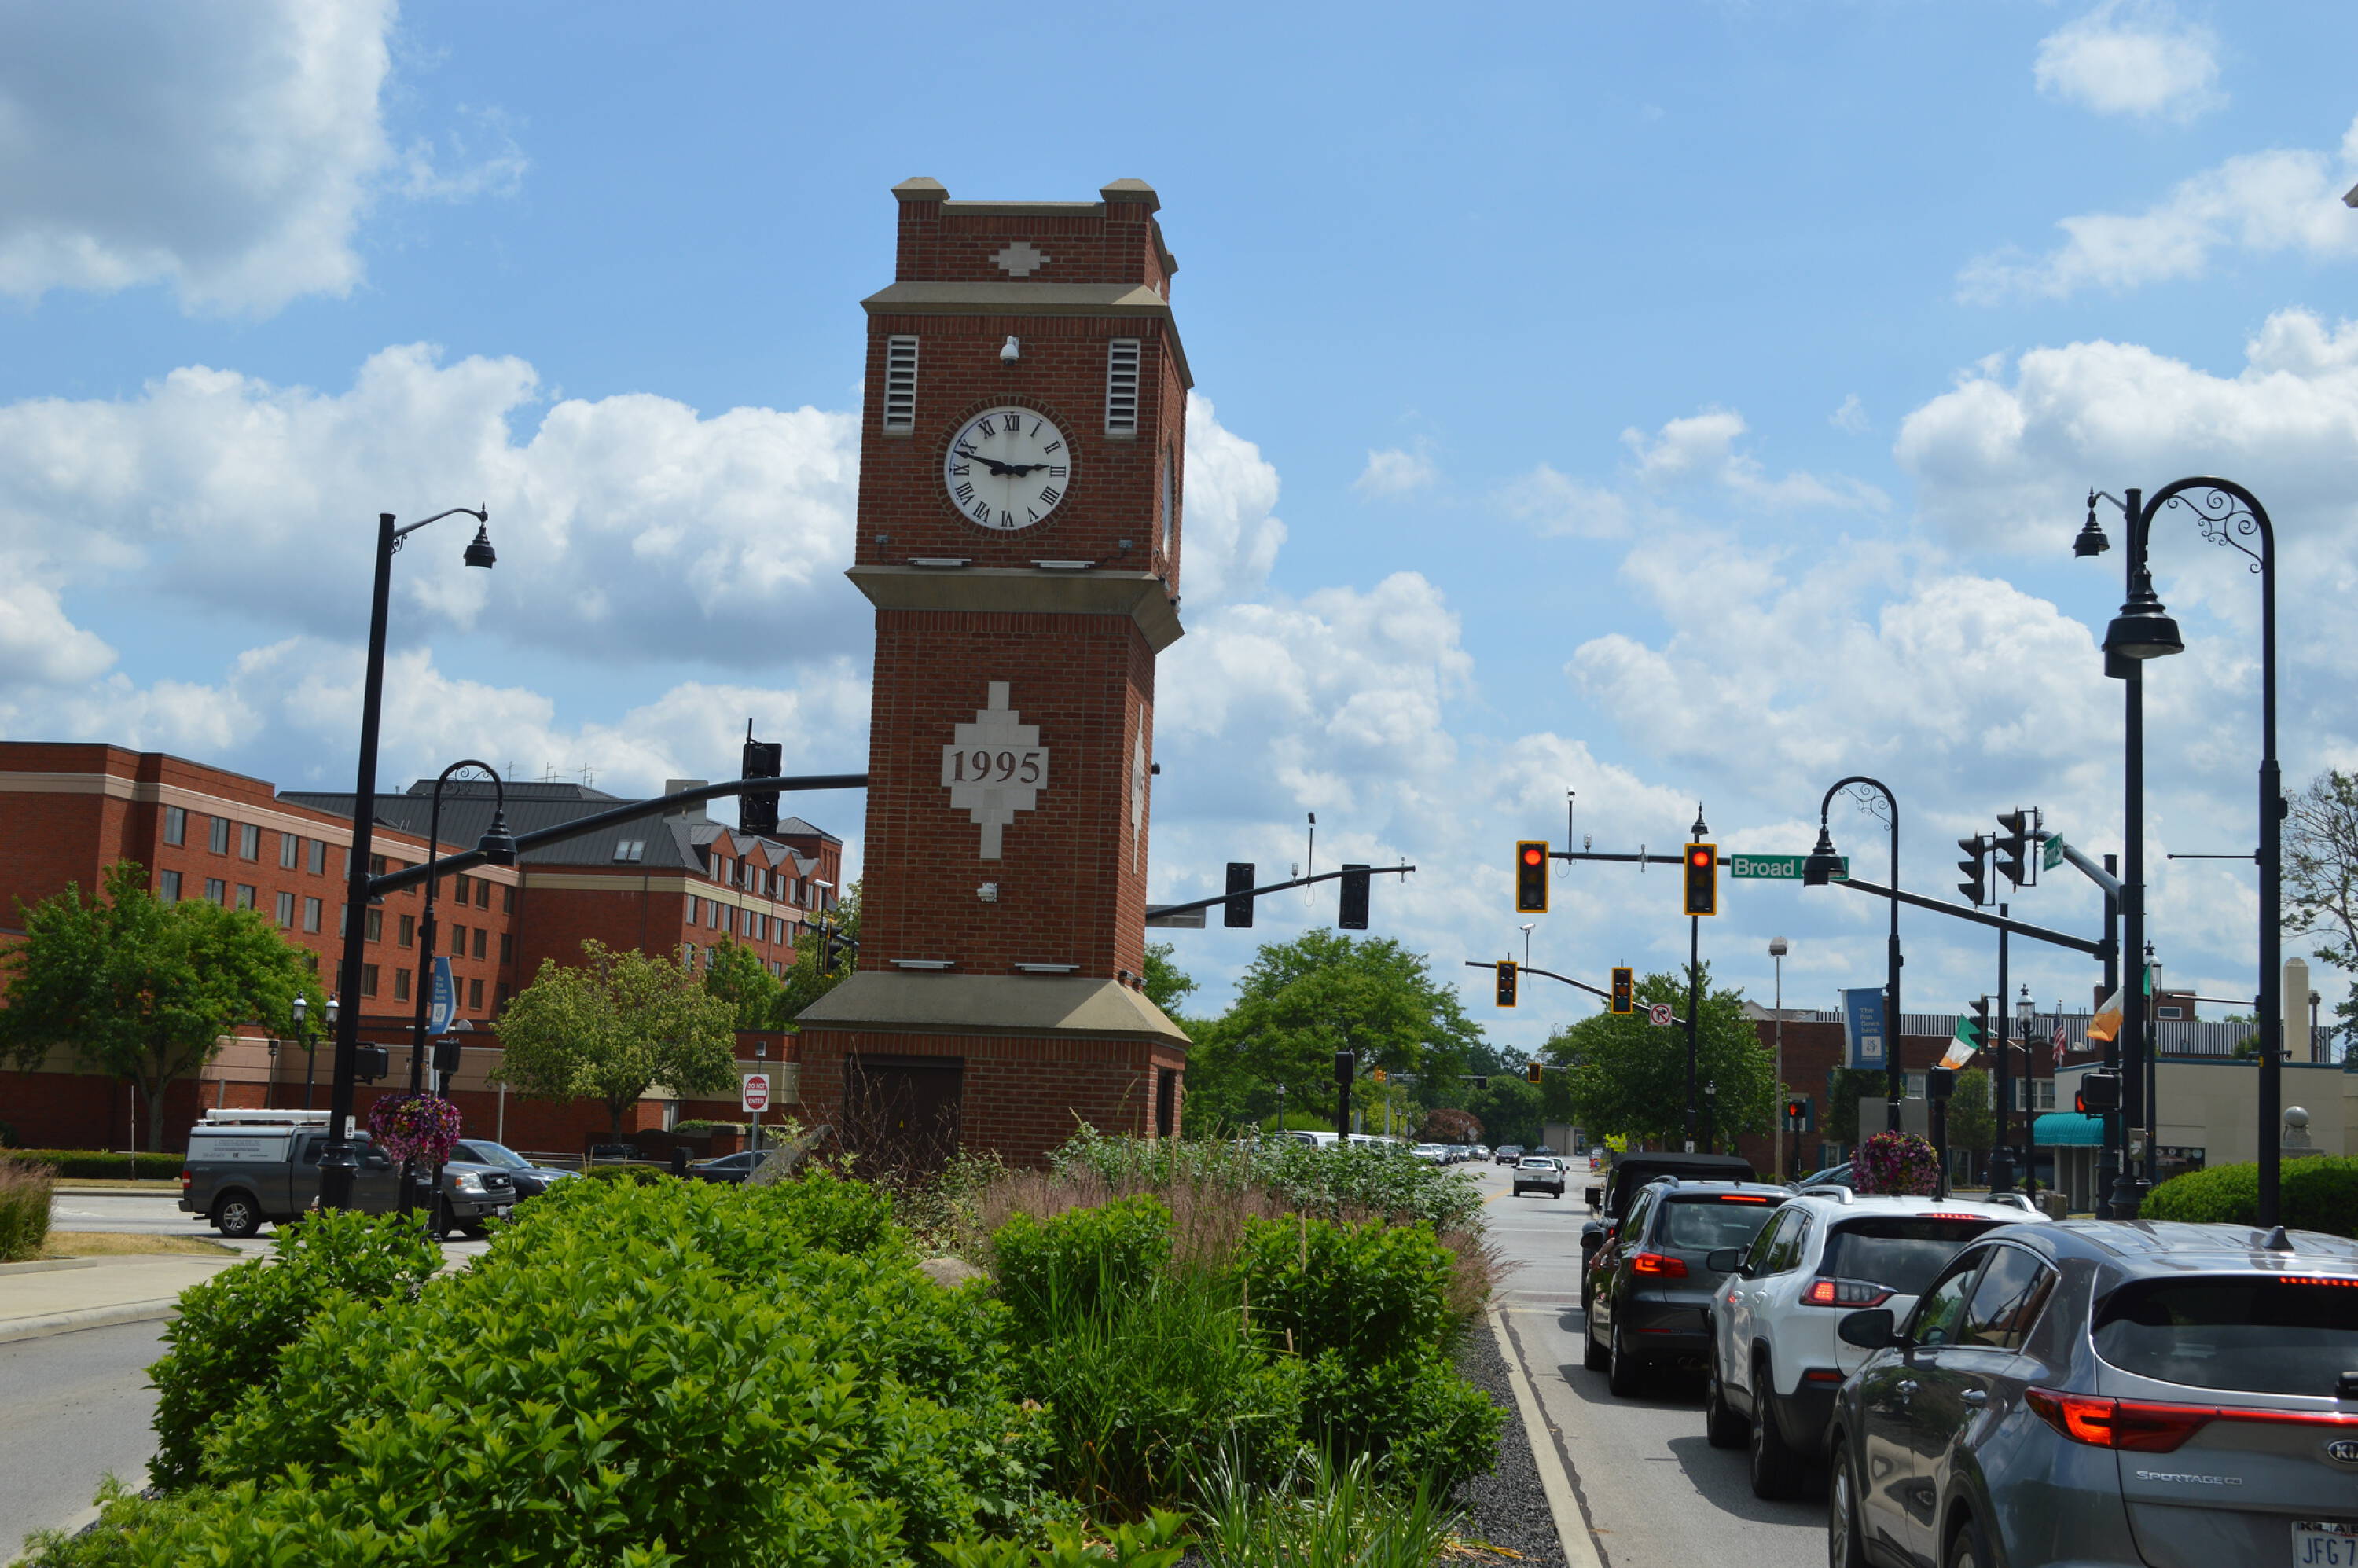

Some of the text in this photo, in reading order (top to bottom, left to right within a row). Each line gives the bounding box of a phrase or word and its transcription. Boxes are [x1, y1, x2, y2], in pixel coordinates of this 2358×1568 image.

[979, 420, 996, 439] XI
[1004, 415, 1020, 431] XII
[960, 439, 977, 454] X
[1044, 440, 1061, 454] II
[1049, 465, 1066, 478] III
[1001, 511, 1014, 527] VI
[1027, 506, 1038, 522] V
[951, 751, 1040, 783] 1995
[1735, 858, 1794, 876] Broad
[2336, 1445, 2358, 1460] KI
[2136, 1471, 2222, 1485] SPORTAGE
[2302, 1537, 2338, 1565] JFG
